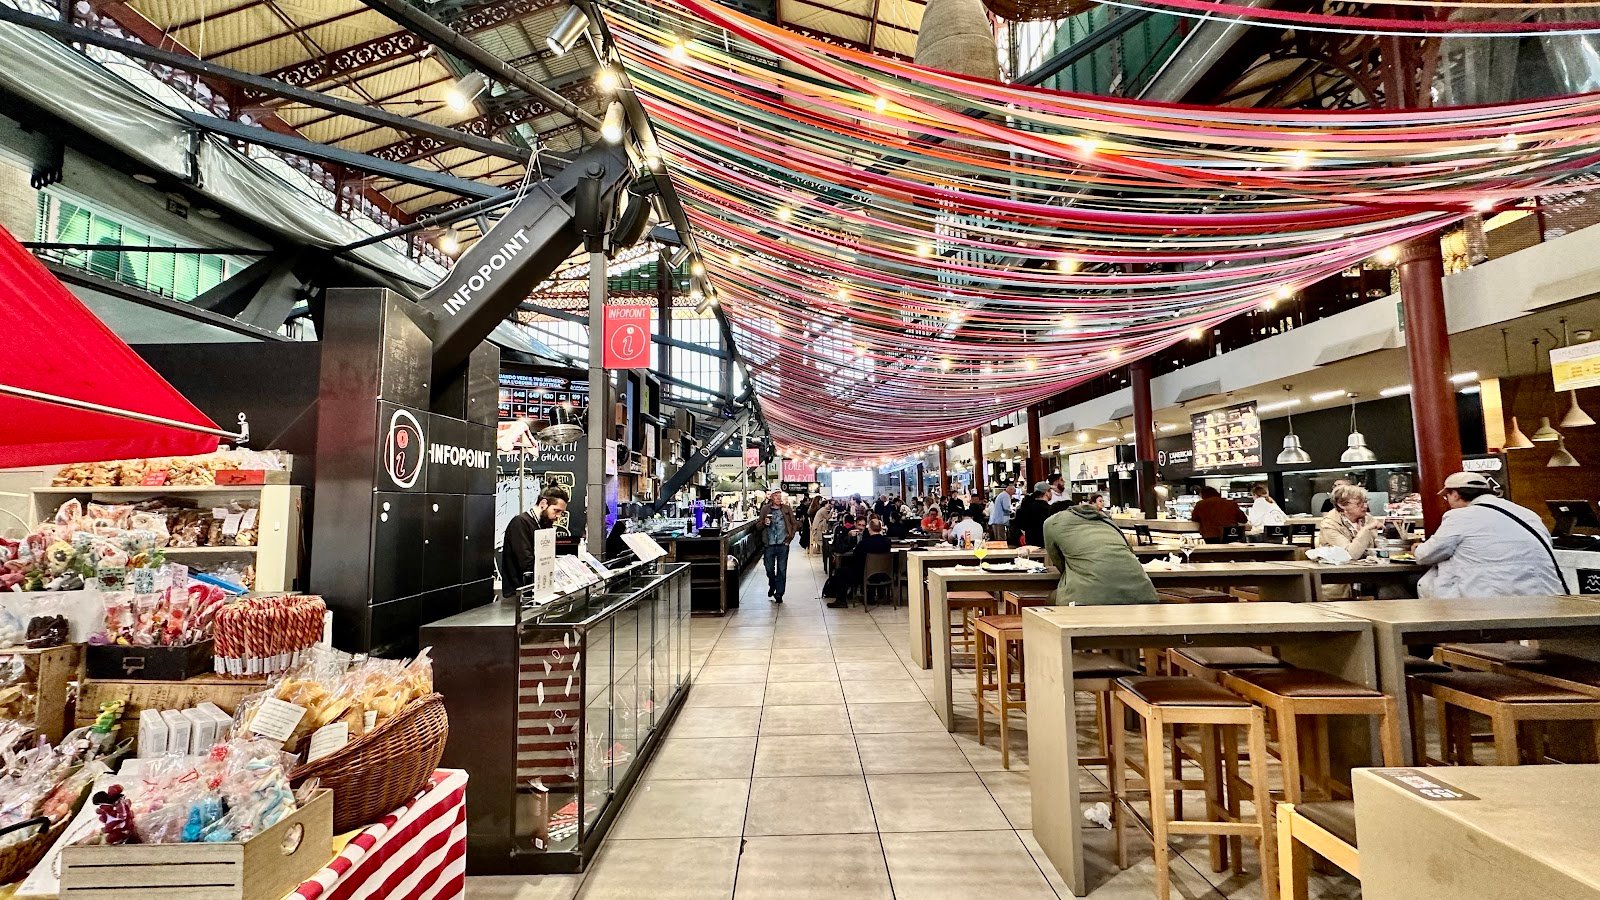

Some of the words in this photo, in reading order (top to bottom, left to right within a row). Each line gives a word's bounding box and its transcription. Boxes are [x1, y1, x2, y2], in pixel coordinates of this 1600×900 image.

[443, 229, 529, 316] INFOPOINT
[608, 308, 648, 319] INFOPOINT
[430, 443, 491, 469] INFOPOINT
[541, 453, 576, 462] GHIACCIO
[784, 461, 805, 471] TOILET
[1113, 463, 1127, 472] PICK
[1127, 462, 1135, 471] UP
